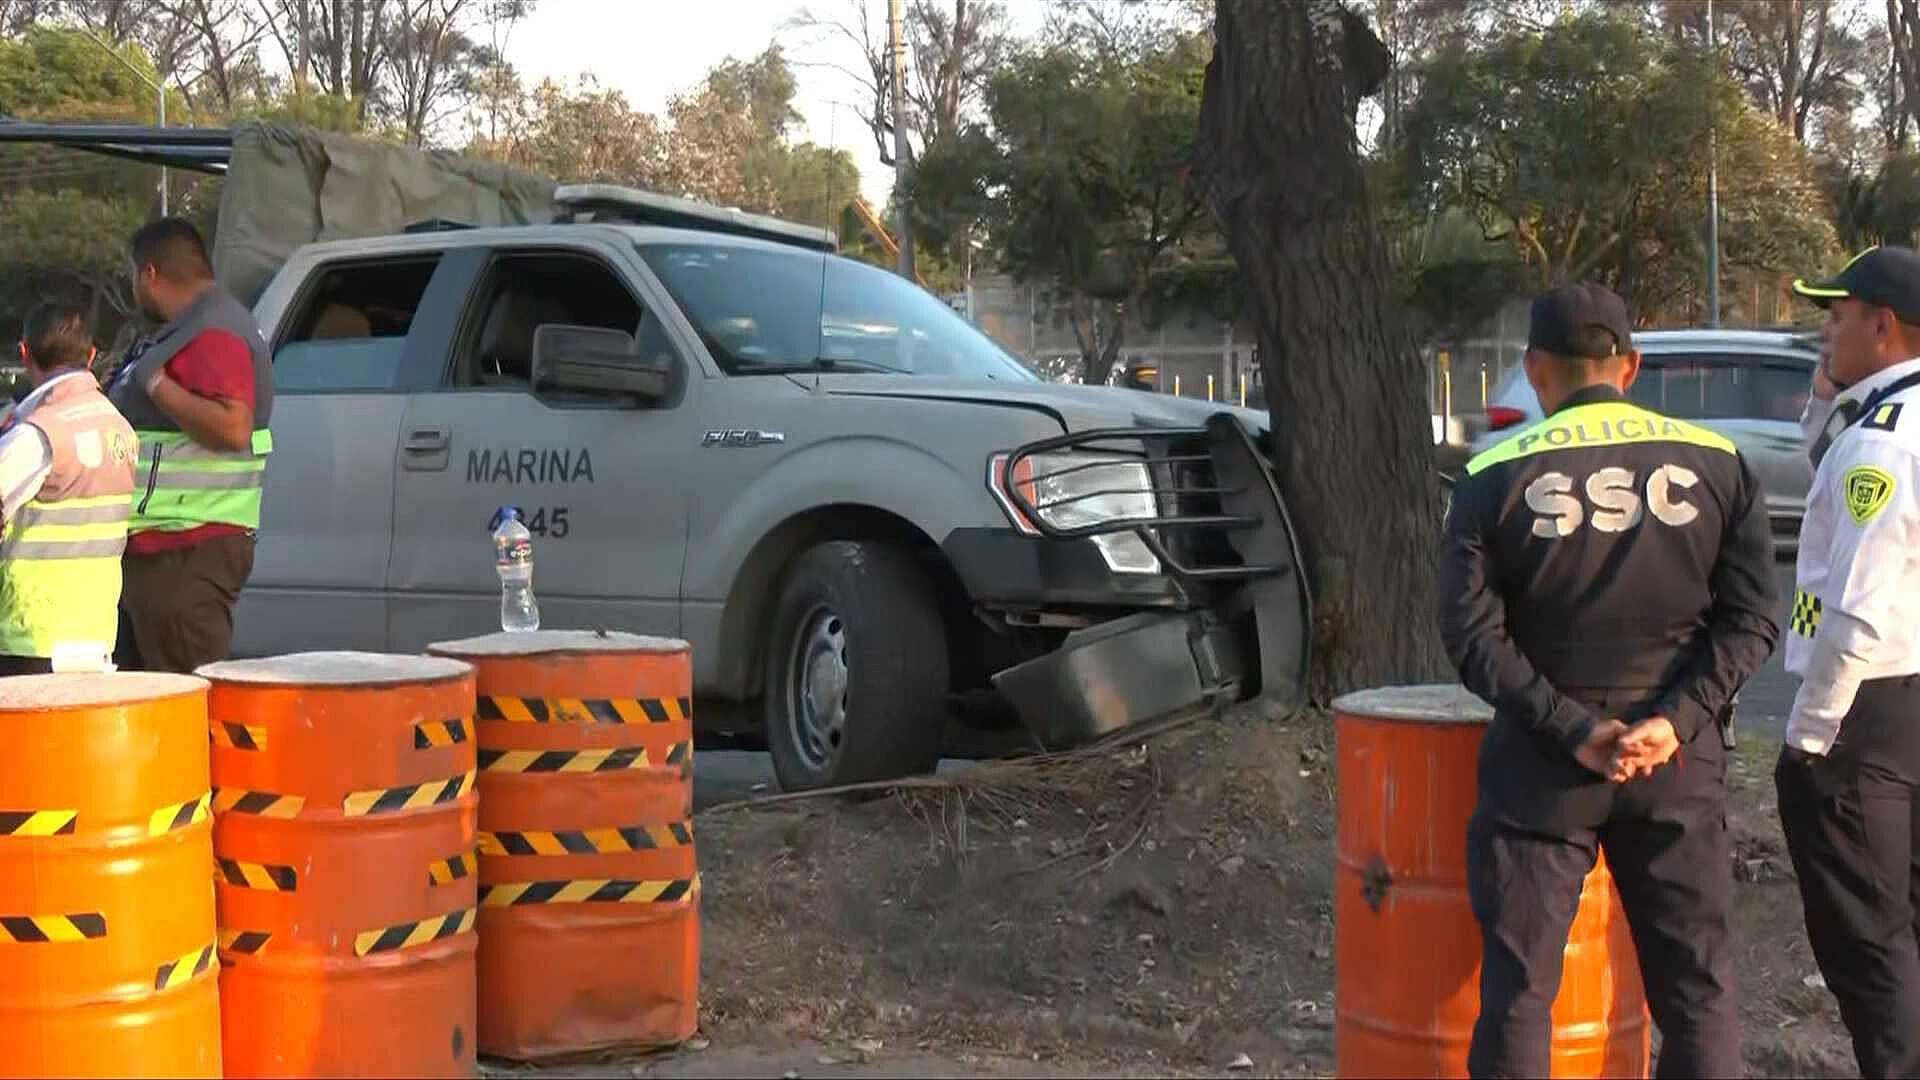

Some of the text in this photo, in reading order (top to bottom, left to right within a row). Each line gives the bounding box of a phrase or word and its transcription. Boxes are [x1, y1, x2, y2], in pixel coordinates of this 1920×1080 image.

[1517, 418, 1682, 453] POLICIA
[466, 449, 594, 483] MARINA
[1524, 463, 1699, 538] SSC
